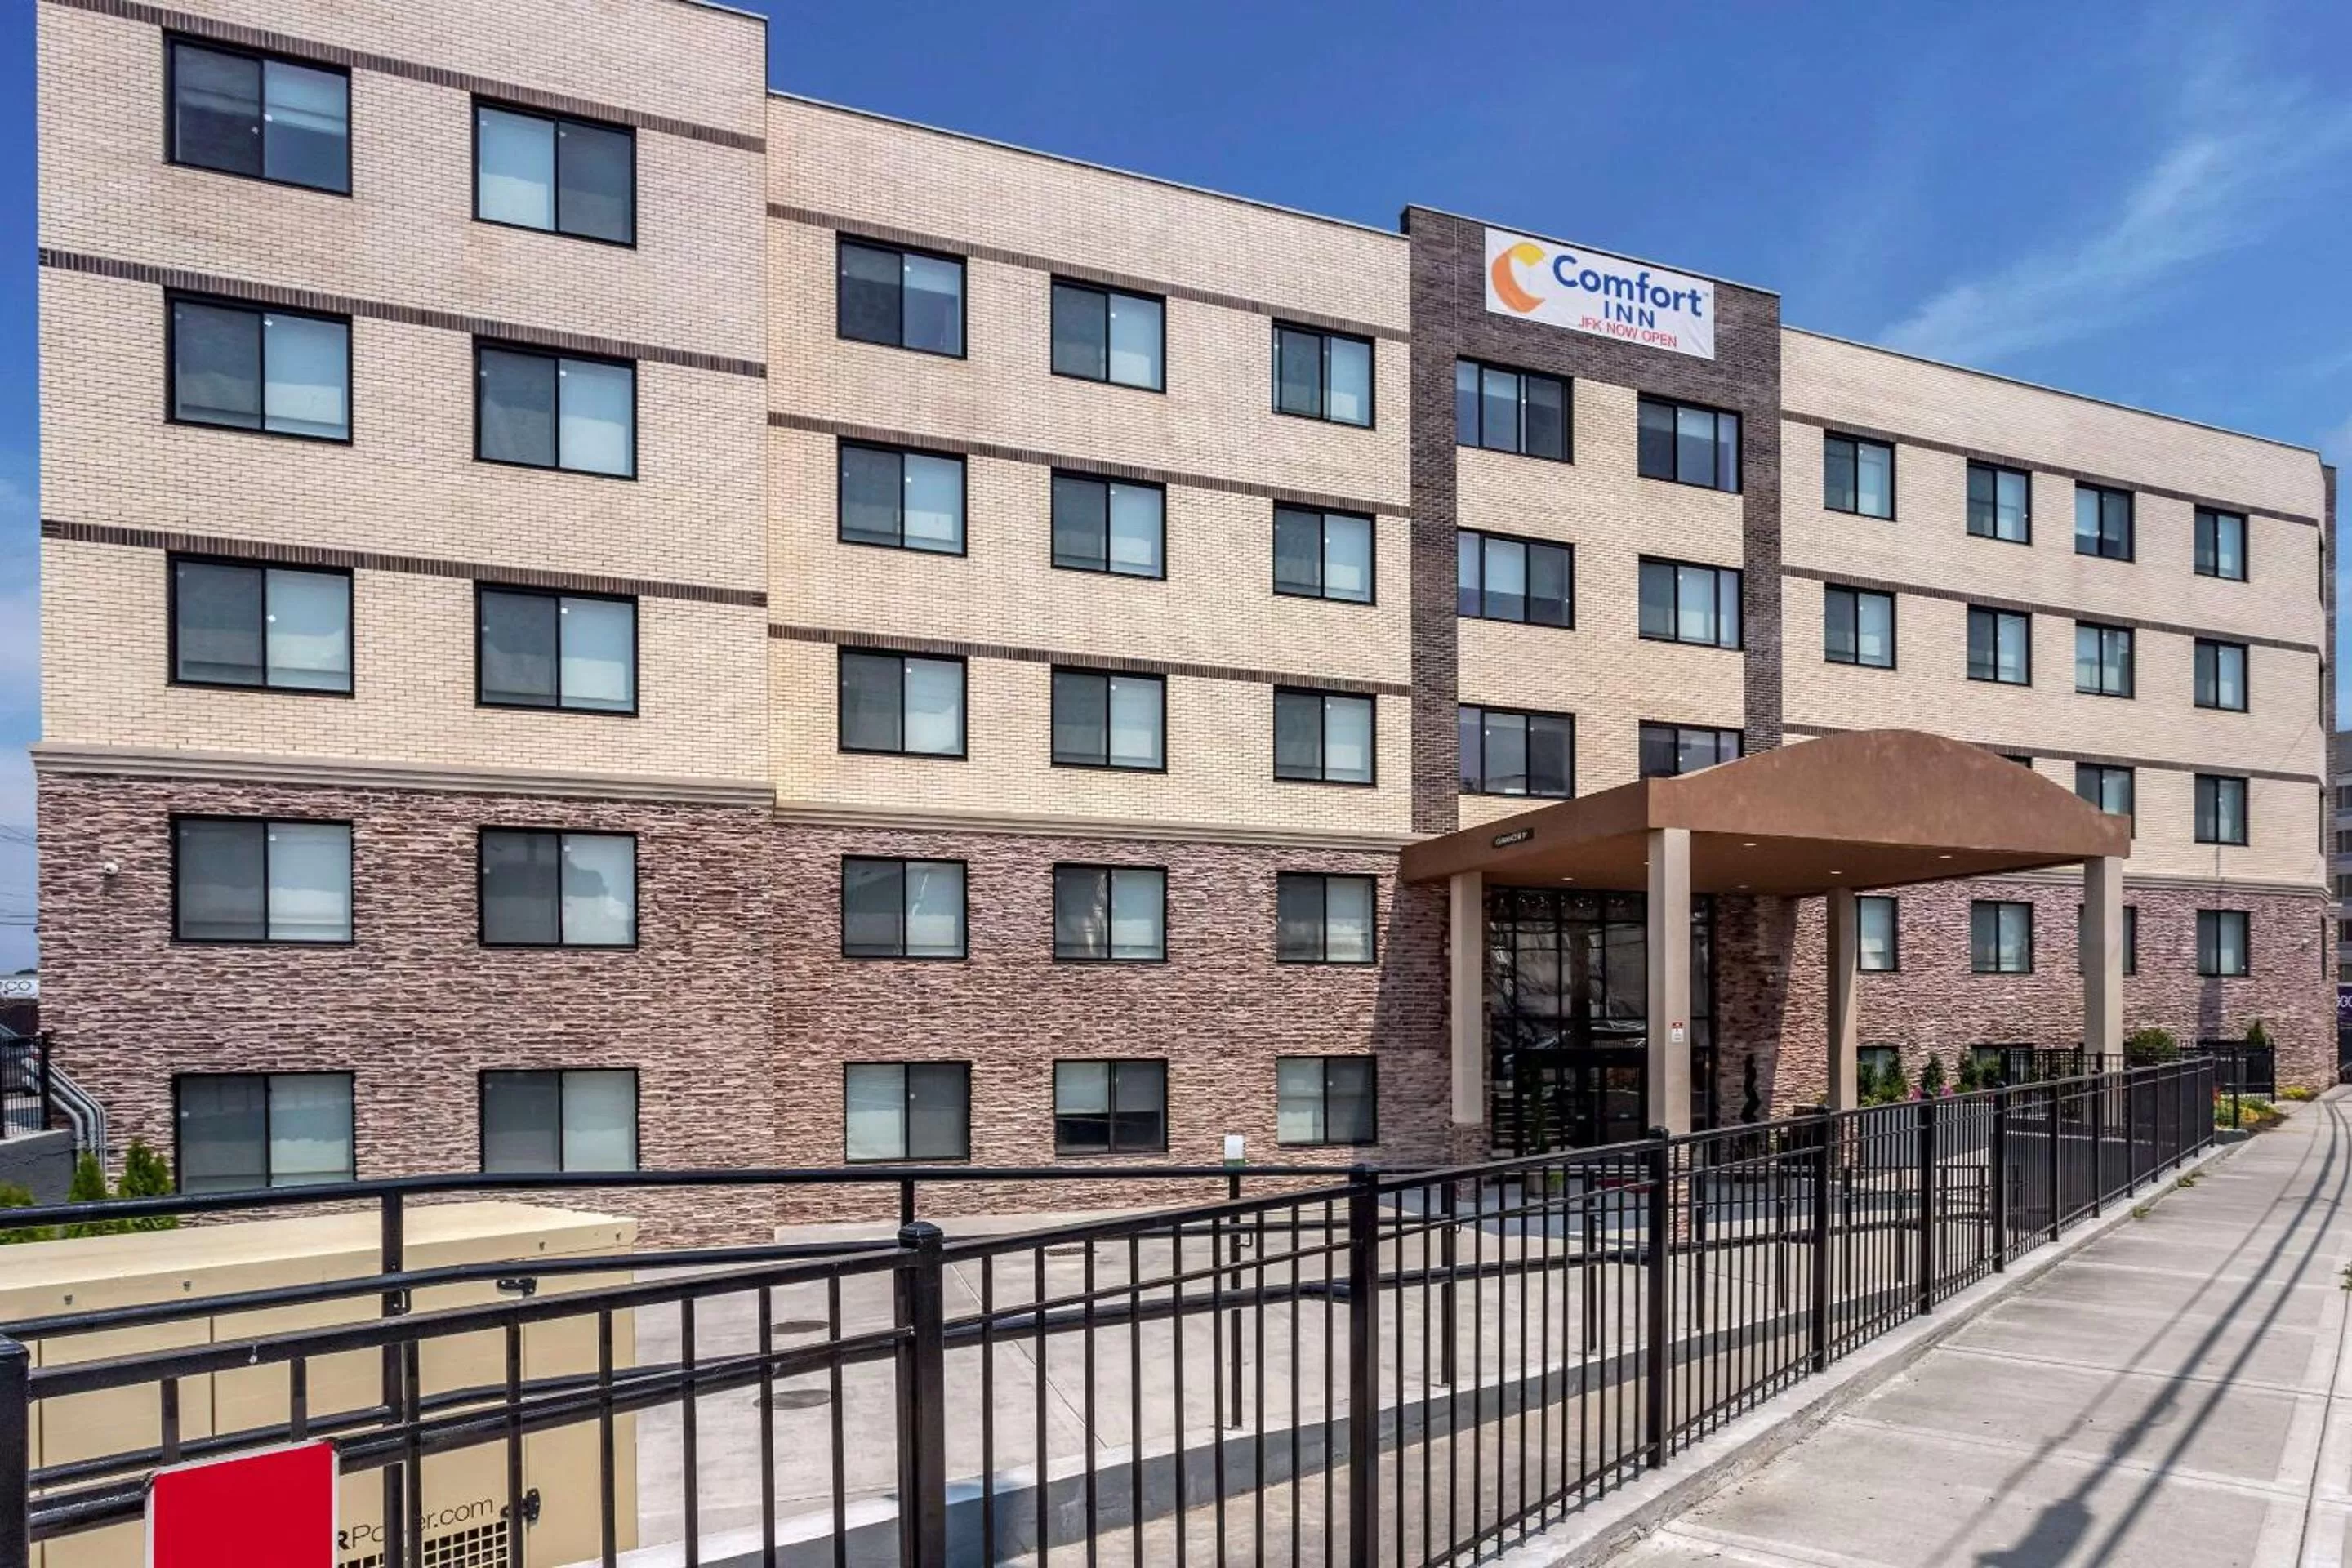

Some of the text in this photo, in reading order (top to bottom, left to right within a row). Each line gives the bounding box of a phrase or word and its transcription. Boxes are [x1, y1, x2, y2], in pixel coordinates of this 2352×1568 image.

[1553, 255, 1702, 317] Comfort
[1604, 301, 1655, 327] INN
[1579, 316, 1677, 346] JFK NOW OPEN
